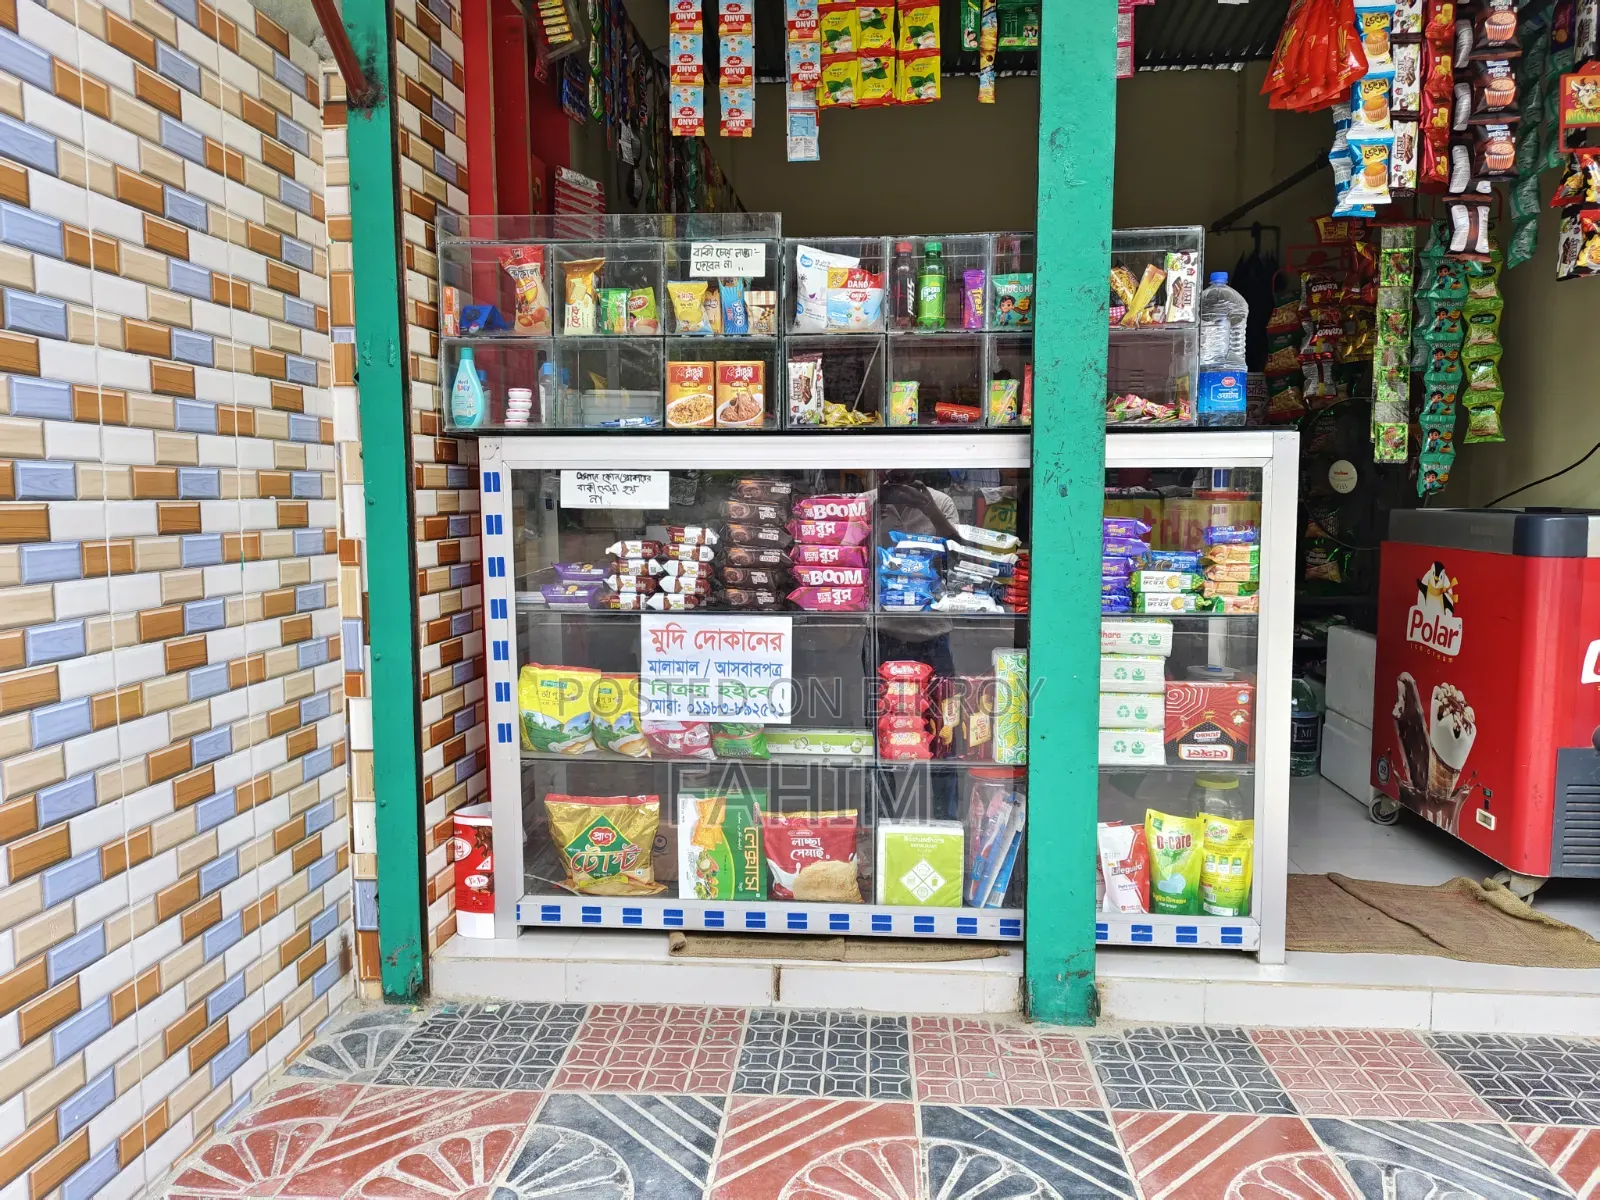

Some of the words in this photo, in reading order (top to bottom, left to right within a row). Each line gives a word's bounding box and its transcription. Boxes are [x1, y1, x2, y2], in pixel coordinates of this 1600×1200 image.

[676, 12, 697, 20] DANO
[725, 14, 745, 22] DANO
[795, 20, 816, 28] DANO
[677, 65, 697, 73] DANO
[725, 67, 745, 75] DANO
[677, 118, 698, 126] DANO
[723, 260, 733, 269] না
[848, 280, 869, 288] DANO
[971, 287, 984, 316] Treat
[571, 305, 581, 328] কেক
[589, 495, 603, 504] না
[812, 502, 867, 520] BOOM
[816, 521, 836, 538] বুম
[819, 548, 840, 564] বুম
[809, 569, 864, 585] BOOM
[832, 588, 852, 605] বুম
[1409, 609, 1459, 649] Polar
[649, 622, 687, 655] মুদি
[694, 628, 785, 653] দোকানের
[647, 659, 700, 676] মালামাল
[714, 660, 784, 678] আসবাবপত্র
[649, 679, 710, 697] বিক্রয়
[715, 680, 773, 700] হইবে
[592, 831, 613, 841] প্রাণ
[791, 837, 822, 846] লাচ্ছা
[570, 843, 643, 874] টোস্ট
[790, 848, 824, 860] সেমাই
[1111, 860, 1143, 877] Lifeguard
